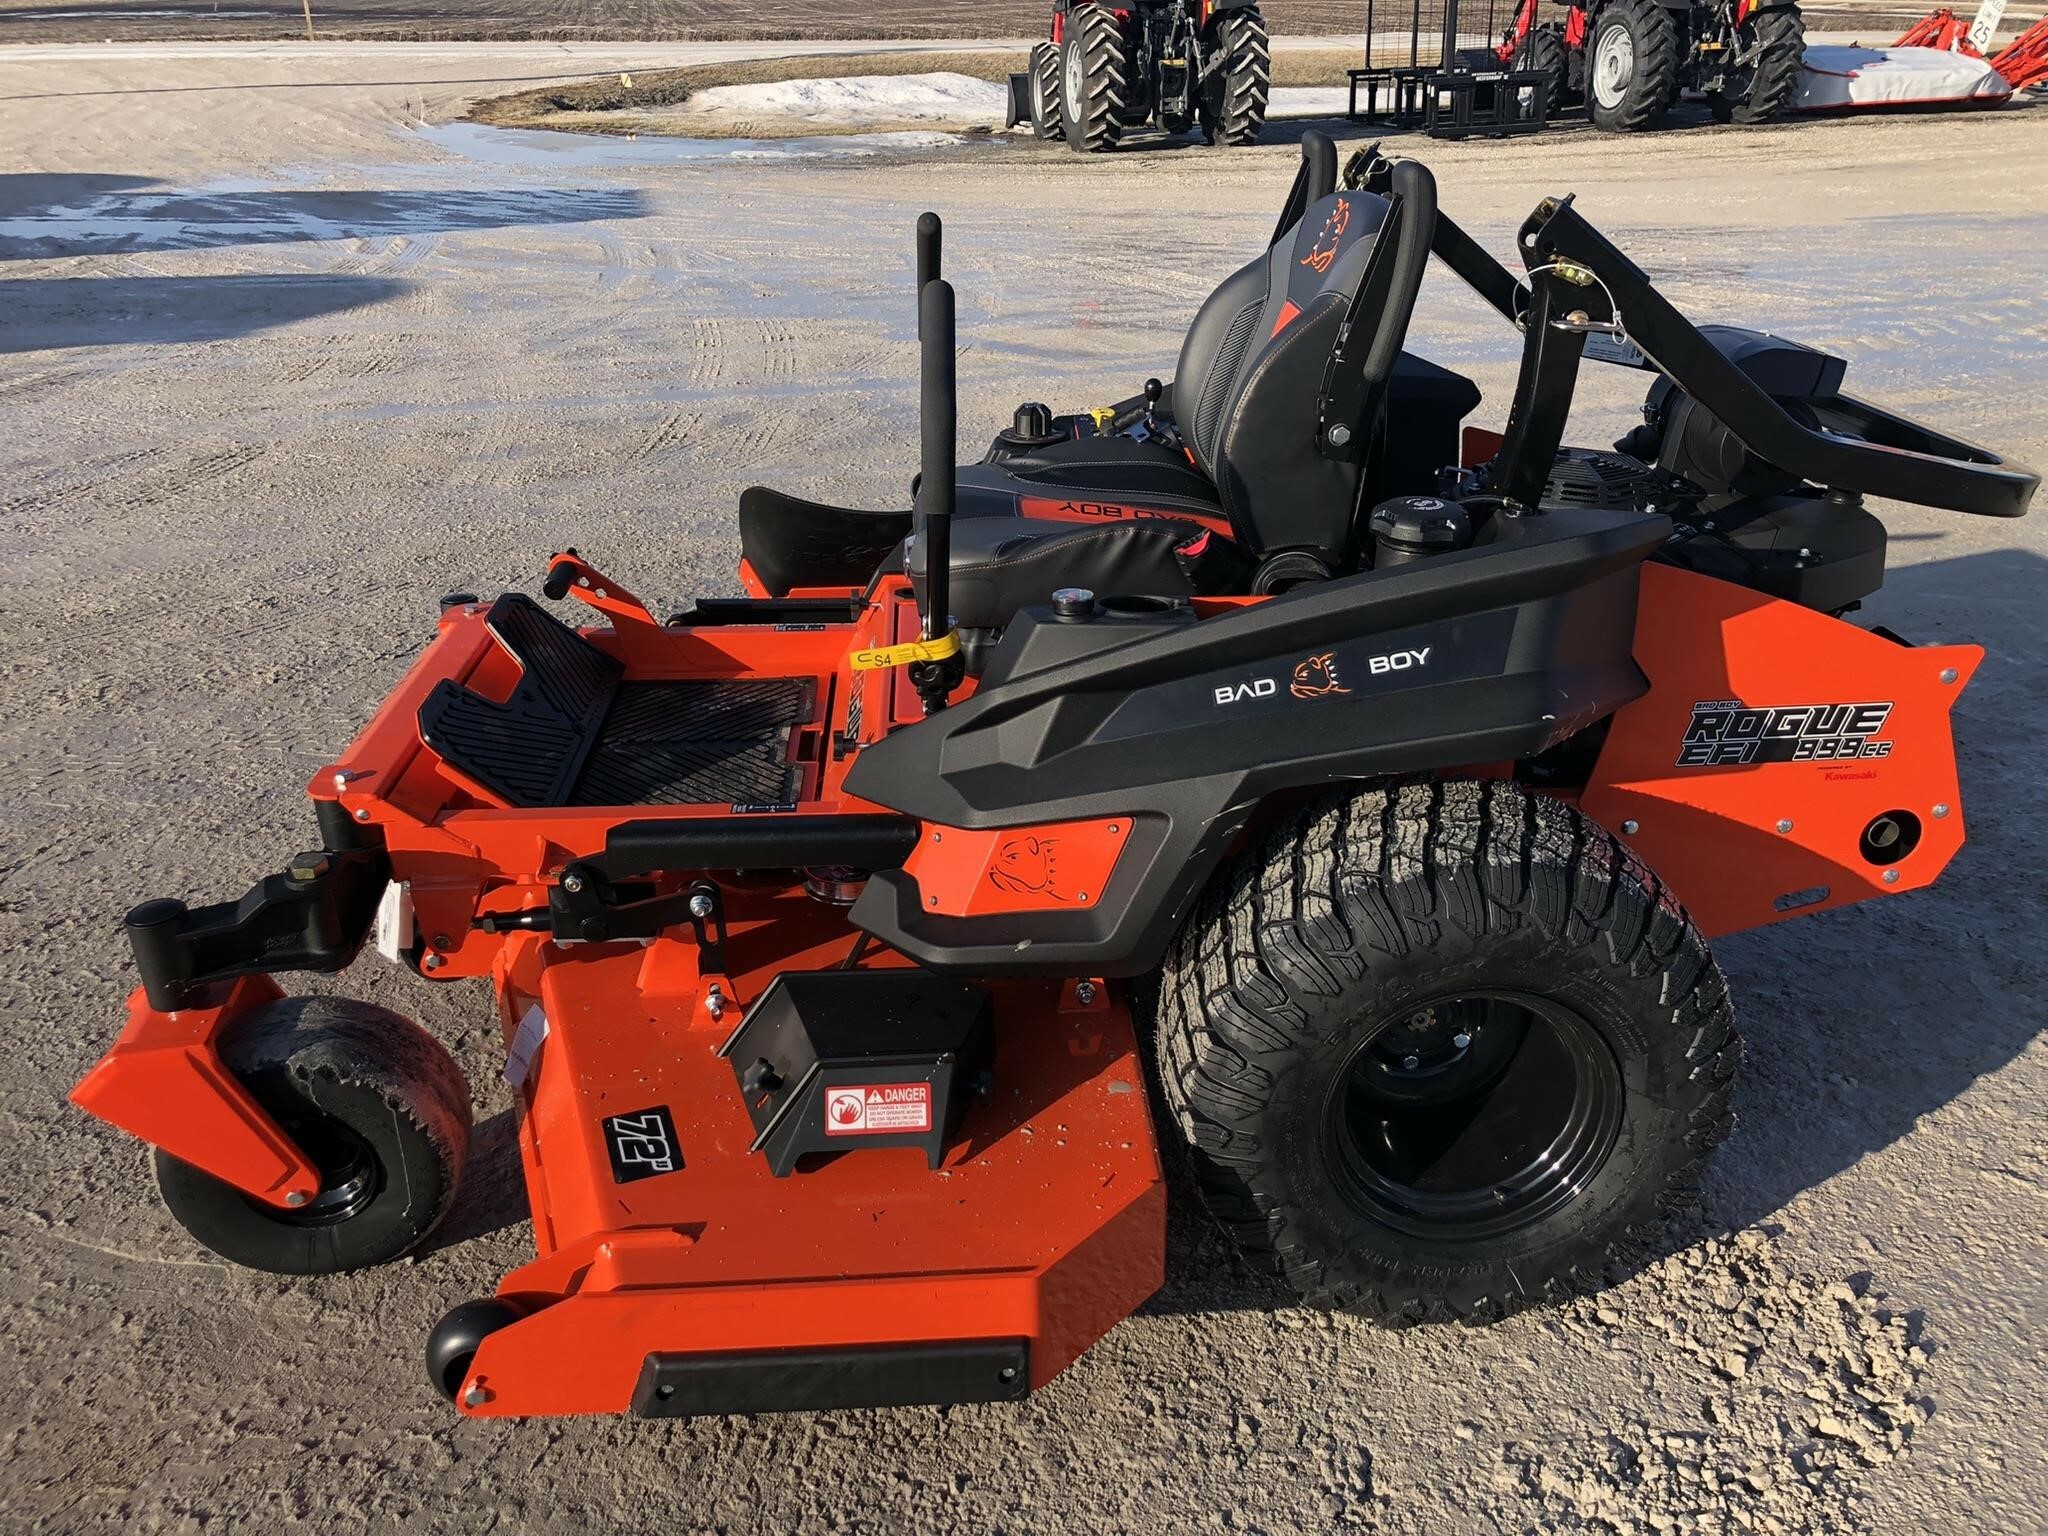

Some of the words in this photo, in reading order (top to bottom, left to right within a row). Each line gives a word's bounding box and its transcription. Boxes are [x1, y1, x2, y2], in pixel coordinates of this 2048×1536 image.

[1974, 21, 1990, 44] 25
[1059, 501, 1122, 517] BOY
[874, 653, 892, 667] S4
[1214, 678, 1277, 705] BAD
[1368, 647, 1431, 675] BOY
[1681, 701, 1895, 743] ROGUE
[1675, 740, 1761, 766] EFI
[1824, 770, 1878, 781] Kawasaki
[885, 1088, 926, 1102] DANGER
